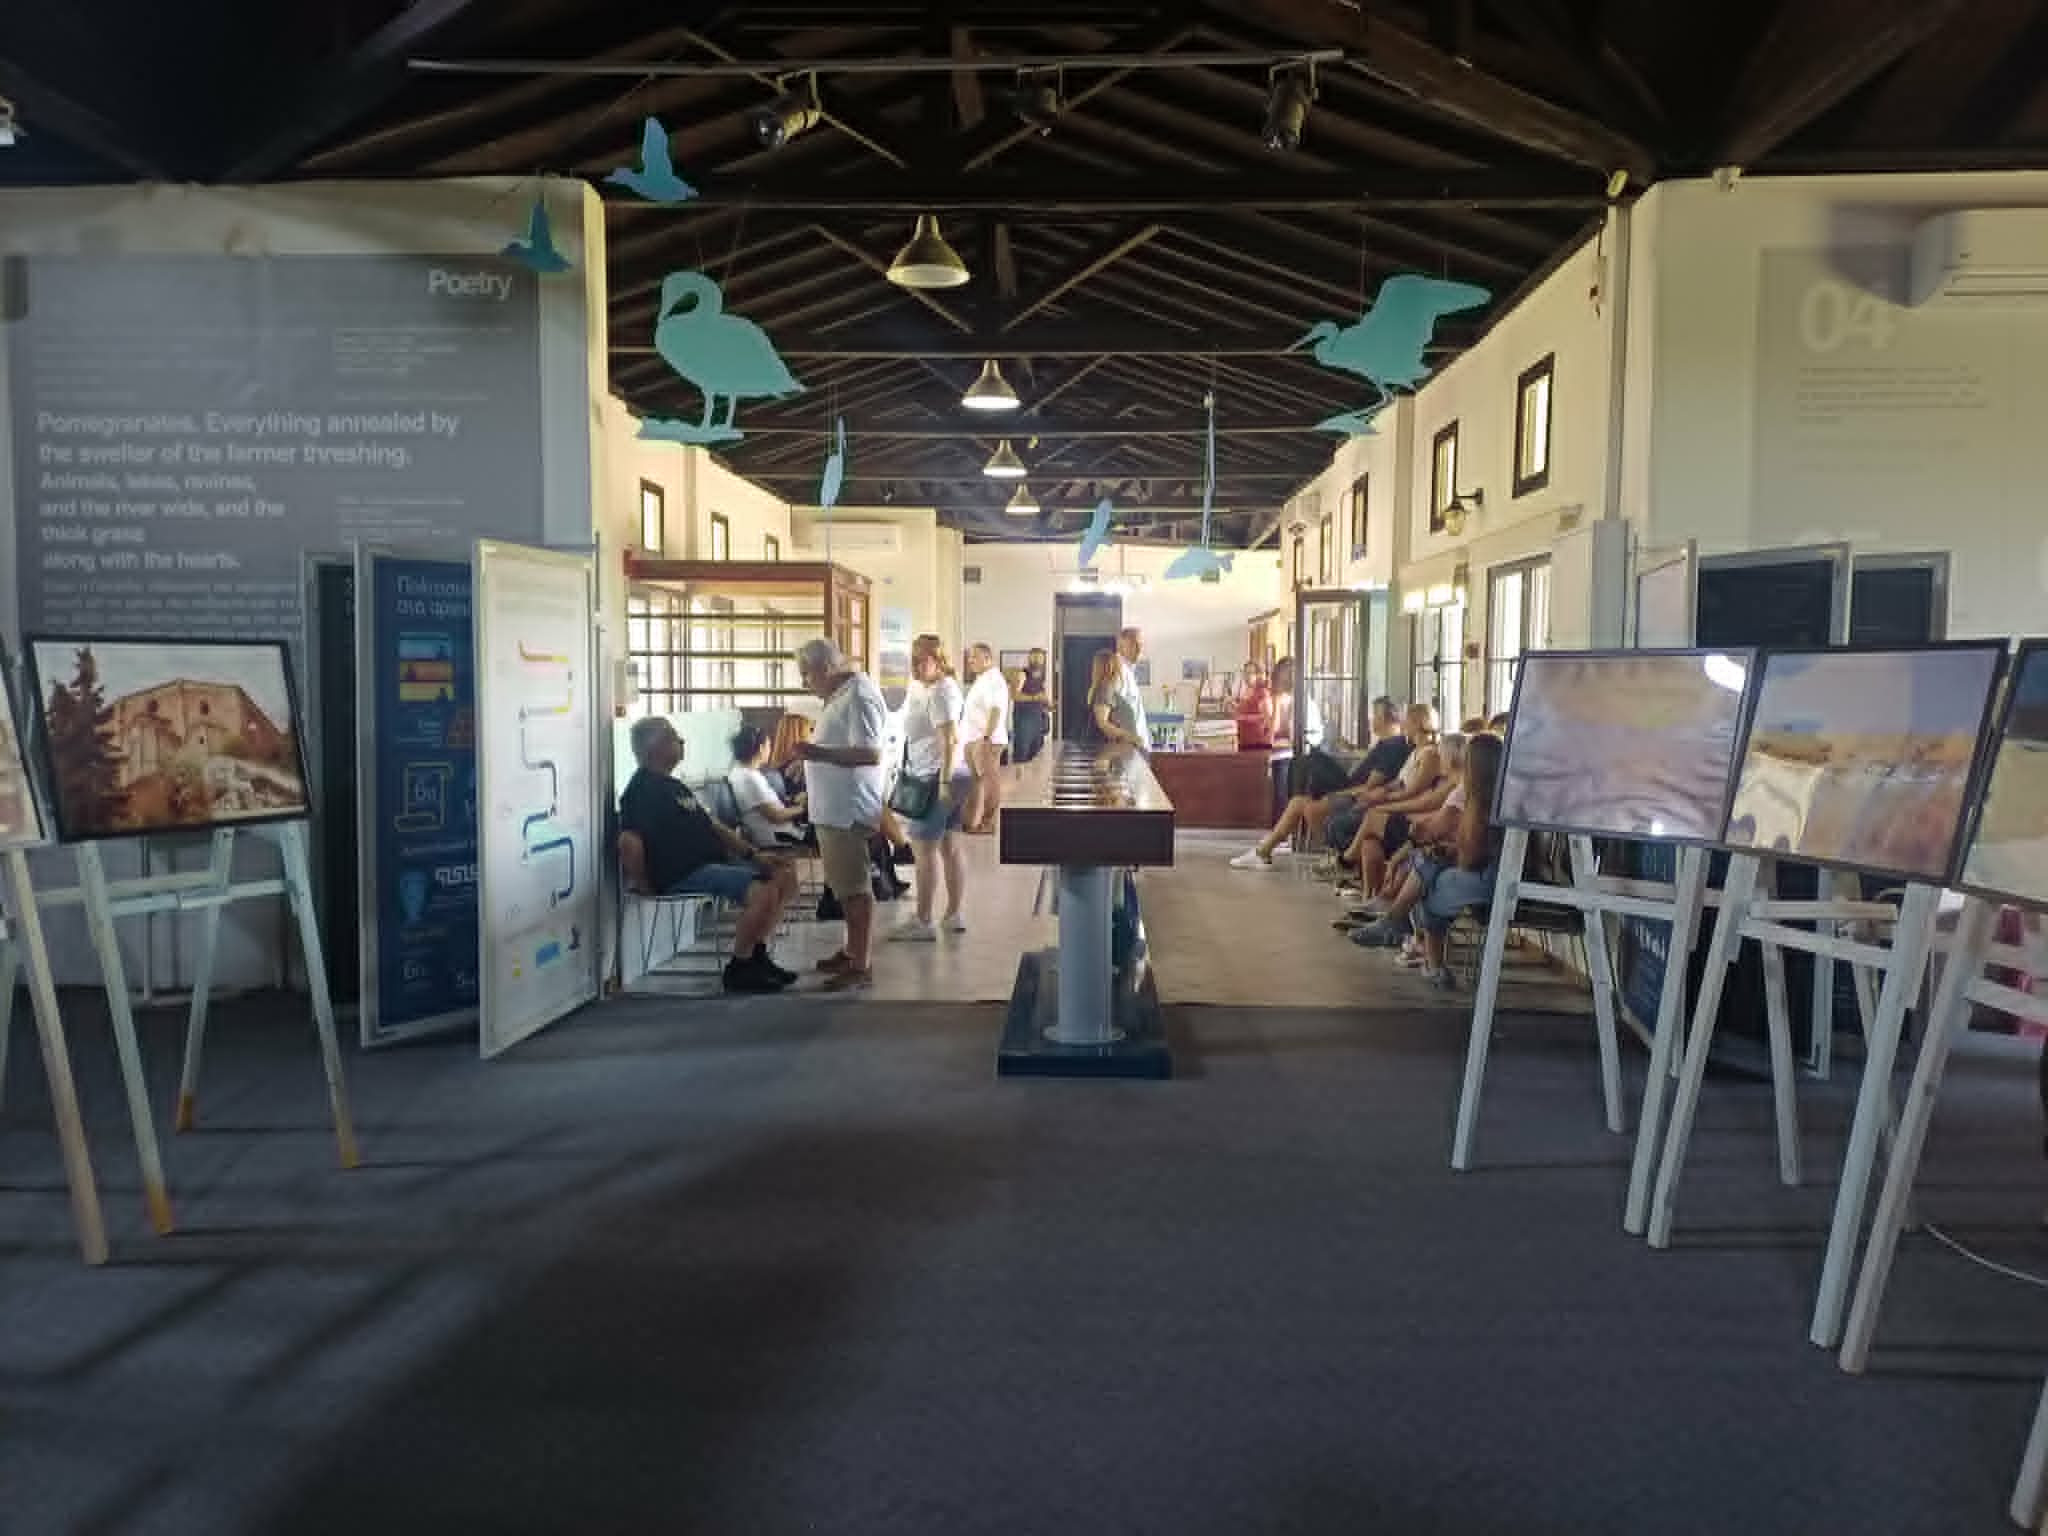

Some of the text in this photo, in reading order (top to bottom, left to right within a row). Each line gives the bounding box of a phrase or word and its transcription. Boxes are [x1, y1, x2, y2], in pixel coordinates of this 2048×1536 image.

[427, 268, 513, 301] Poetry
[1799, 279, 1897, 352] 04
[205, 410, 321, 438] Everything
[327, 410, 426, 434] annealed
[431, 410, 460, 439] by
[38, 441, 73, 464] the
[160, 440, 184, 464] of
[187, 441, 221, 464] the
[40, 499, 76, 518] and
[214, 499, 249, 518] and
[254, 499, 286, 518] the
[143, 552, 173, 569] the
